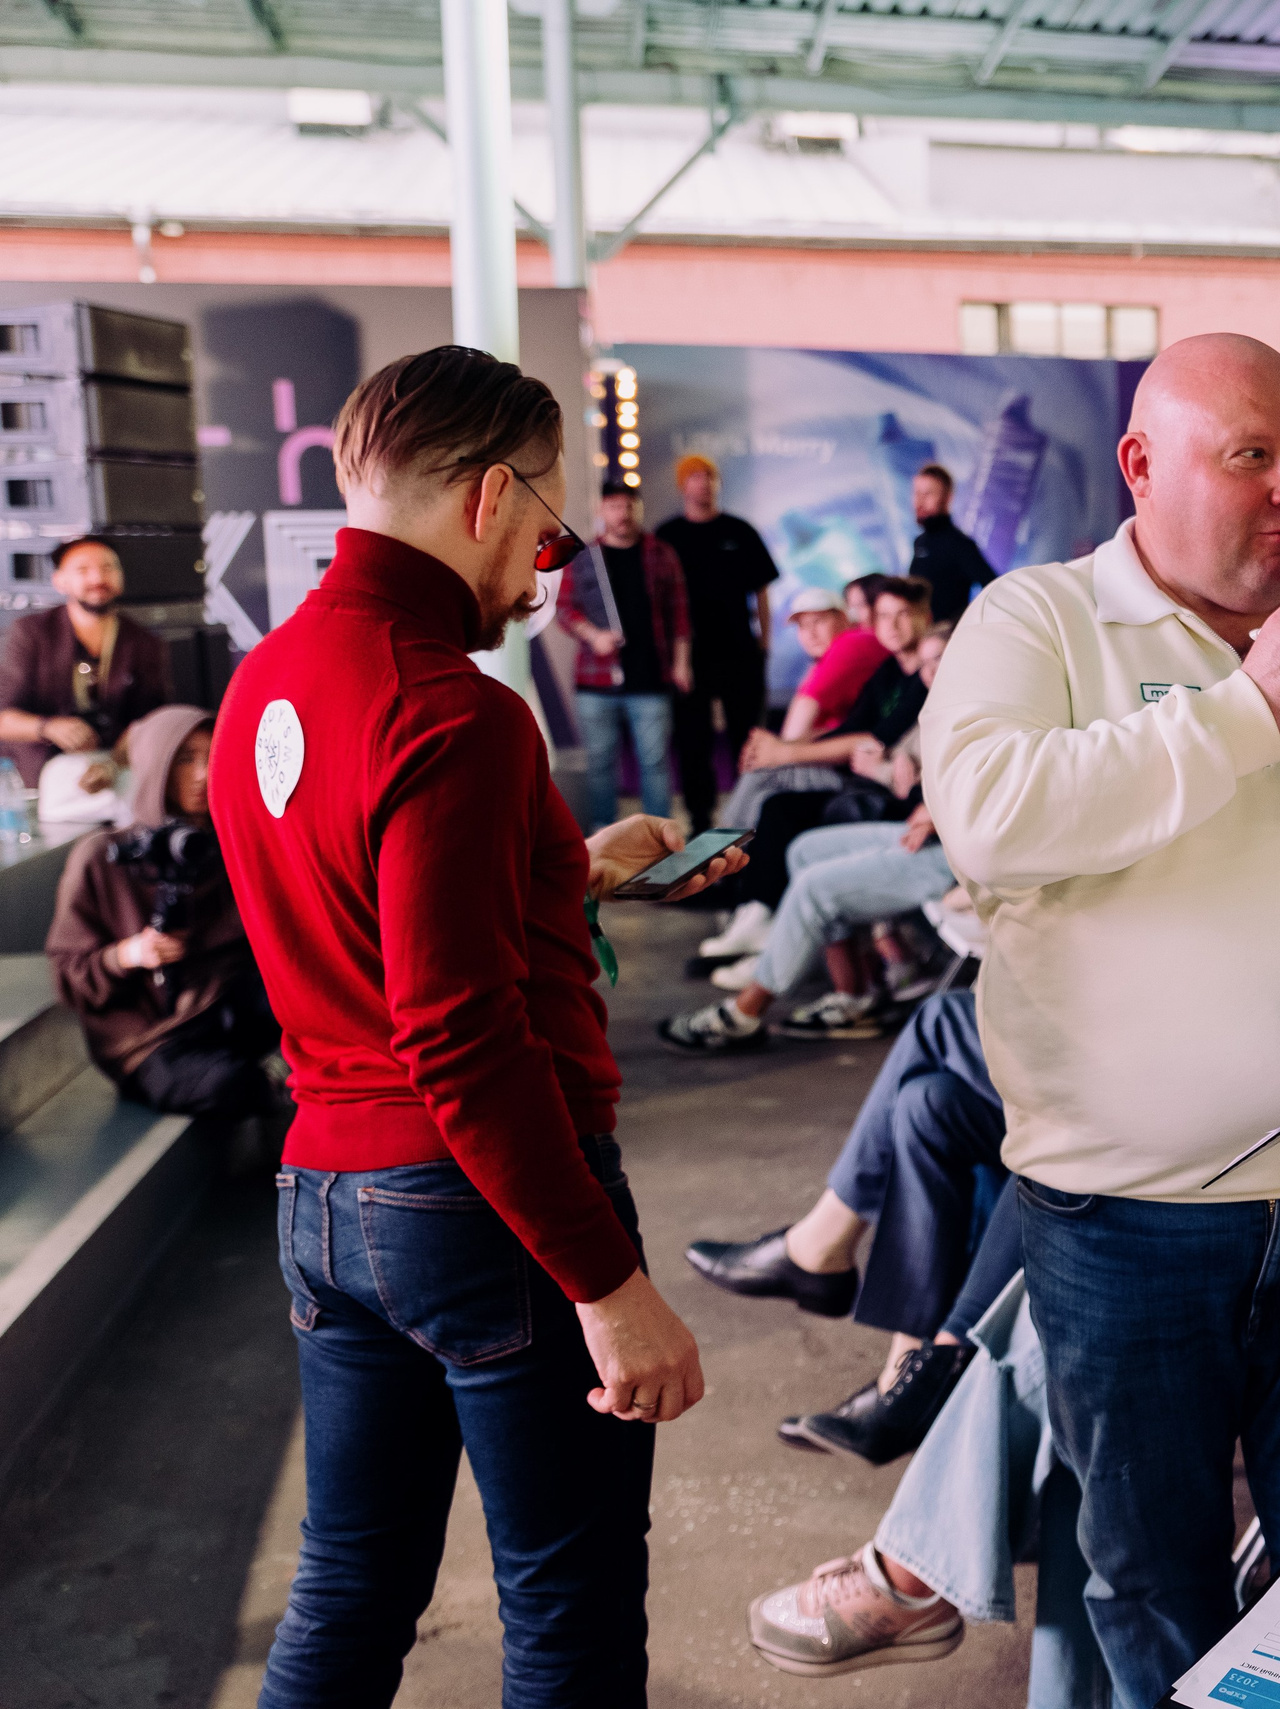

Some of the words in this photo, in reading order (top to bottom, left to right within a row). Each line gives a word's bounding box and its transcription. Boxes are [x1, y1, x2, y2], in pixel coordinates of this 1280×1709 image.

[1240, 1661, 1260, 1672] ЛИСТ
[1228, 1672, 1260, 1688] 2023
[1218, 1687, 1248, 1701] EXPO
